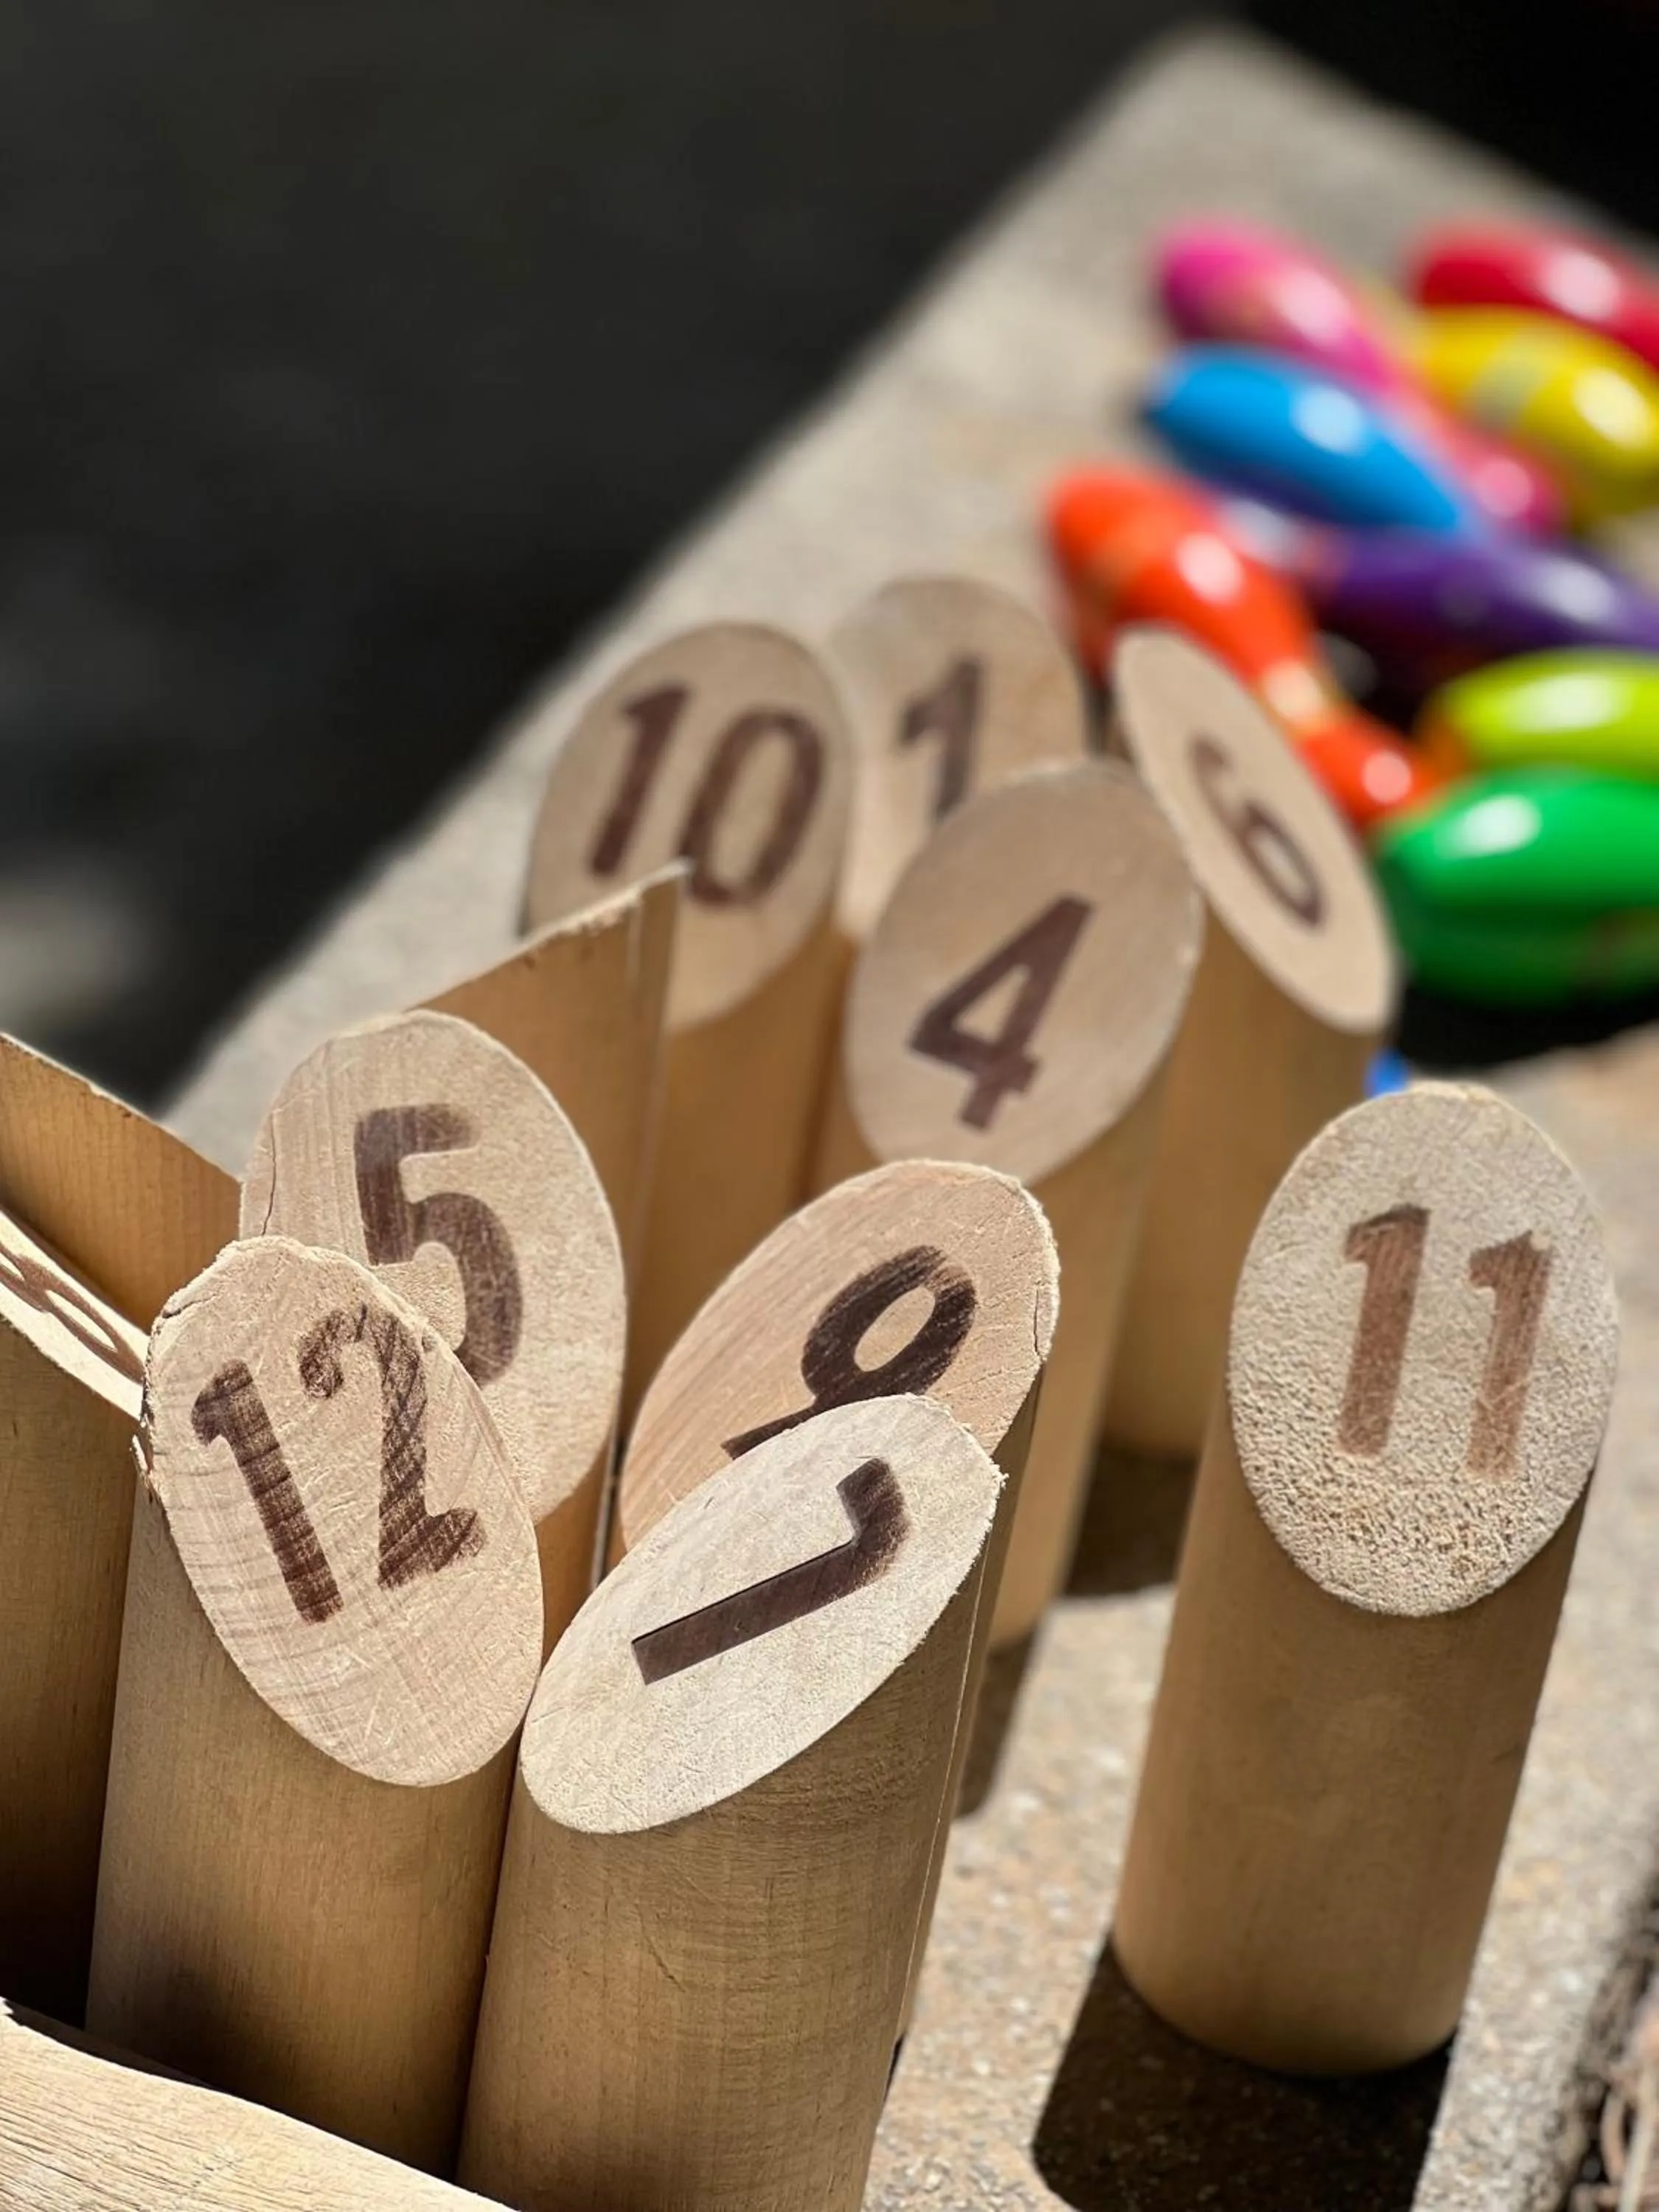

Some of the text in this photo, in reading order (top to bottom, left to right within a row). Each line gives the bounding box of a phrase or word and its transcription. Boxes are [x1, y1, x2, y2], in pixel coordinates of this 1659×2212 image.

[588, 681, 824, 908] 10
[897, 655, 984, 821] 1
[1184, 728, 1325, 928] 6
[907, 894, 1096, 1134] 4
[354, 1102, 524, 1387] 5
[720, 1245, 976, 1462] 9
[1335, 1203, 1553, 1478] 11
[190, 1305, 488, 1623] 12
[631, 1457, 911, 1686] 7
